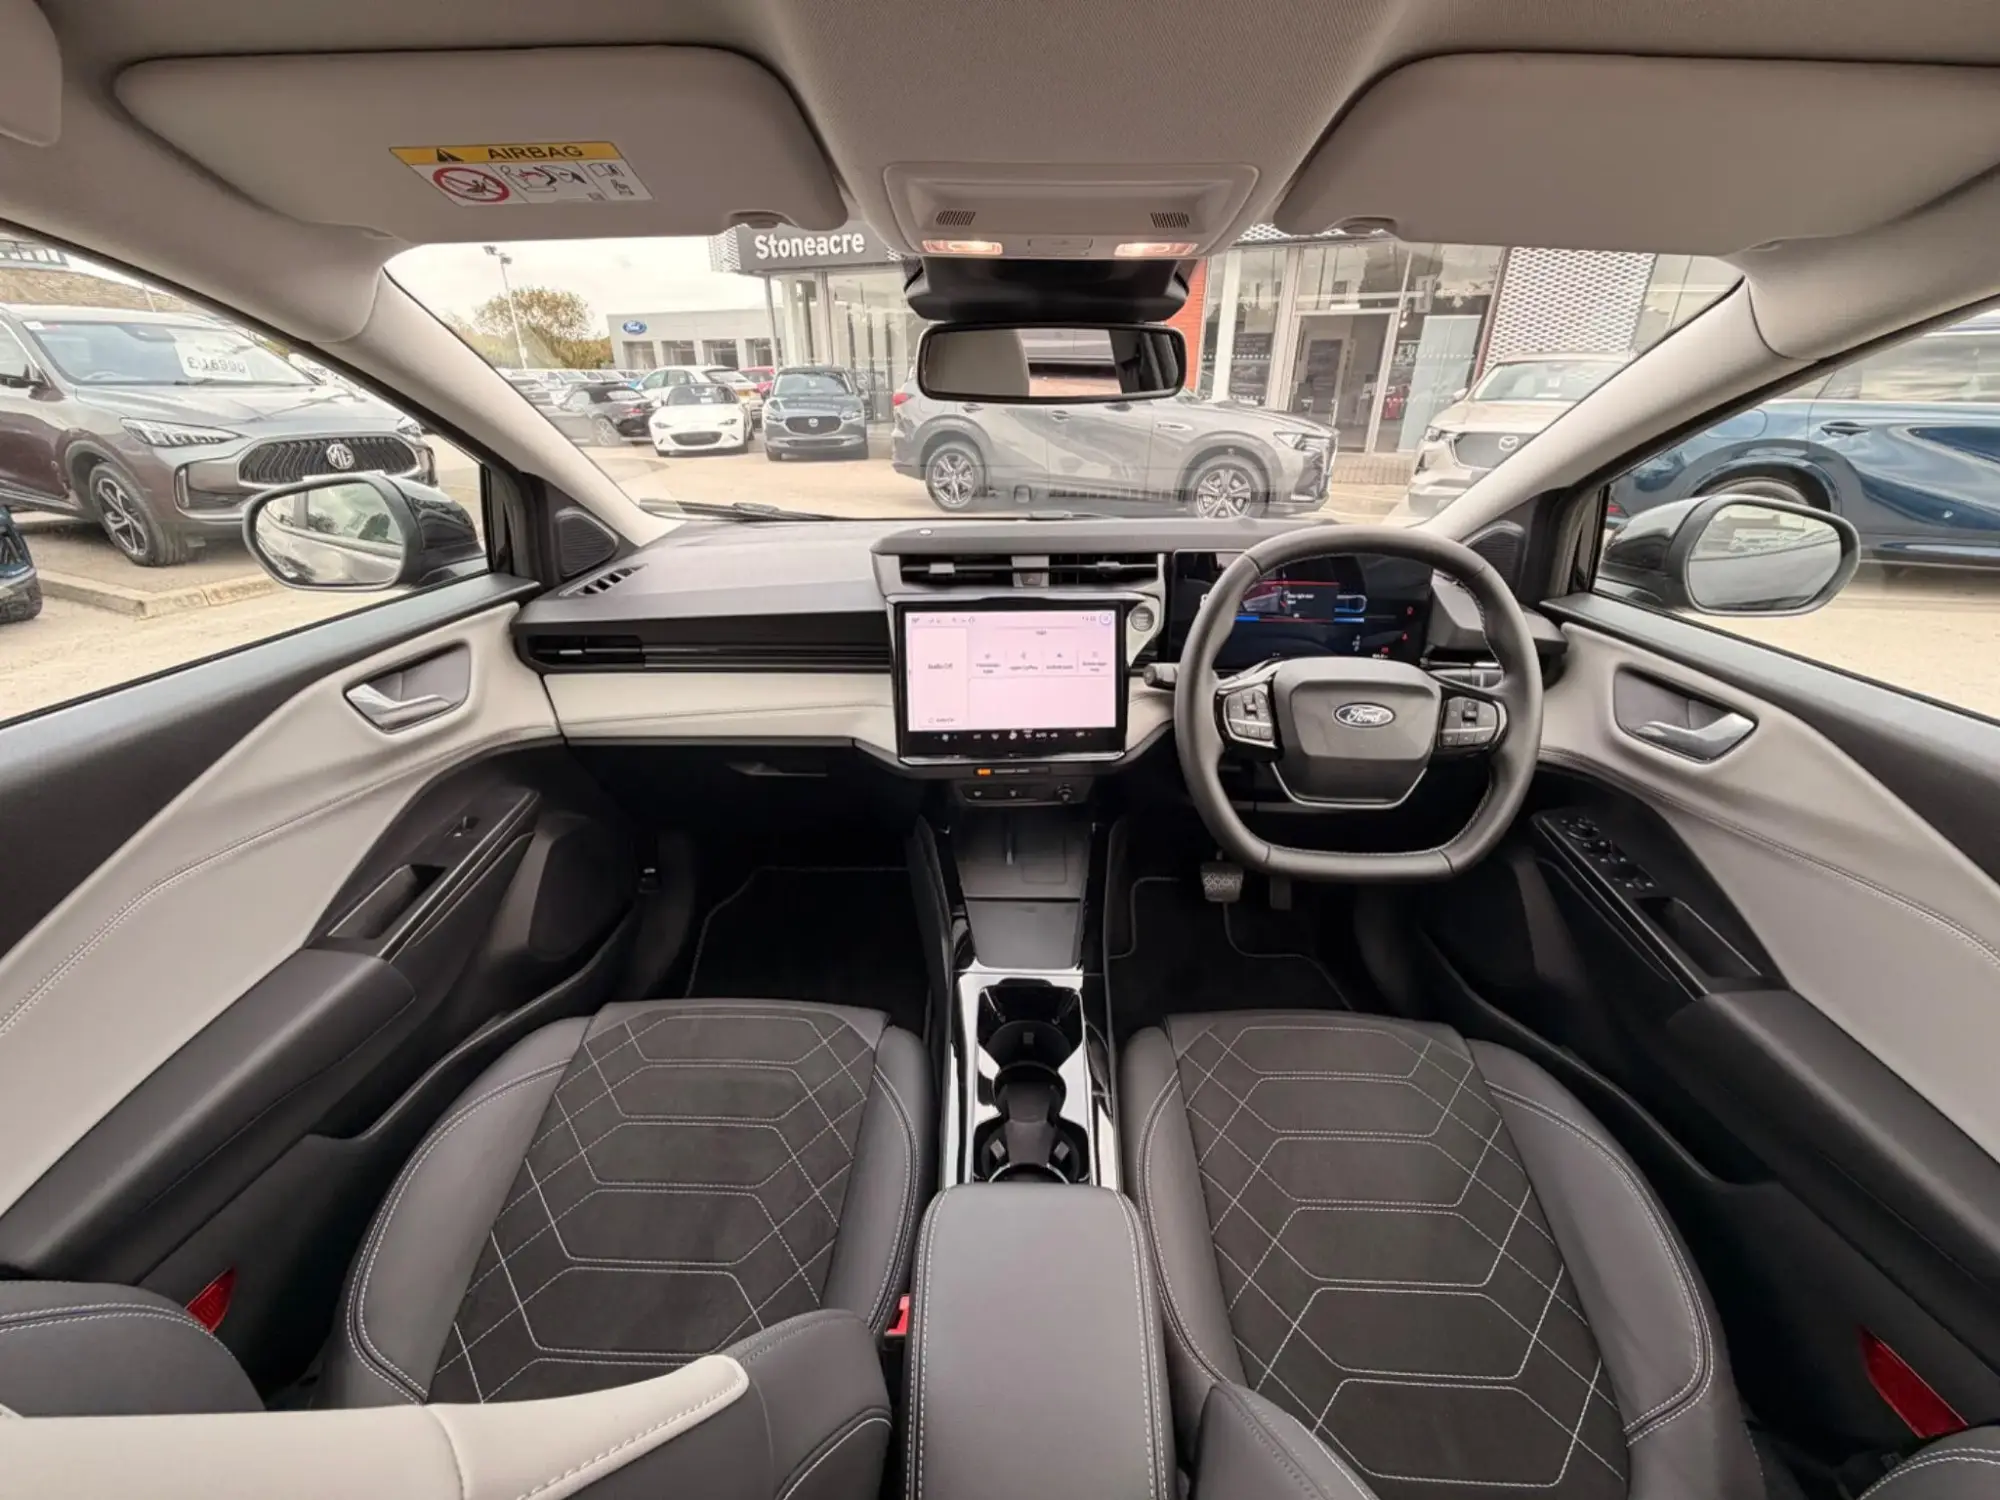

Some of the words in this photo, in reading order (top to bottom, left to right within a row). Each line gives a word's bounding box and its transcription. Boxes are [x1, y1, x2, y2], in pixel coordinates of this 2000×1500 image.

[487, 145, 584, 160] AIRBAG
[754, 232, 866, 260] Stoneacre
[327, 443, 355, 469] MG
[1346, 707, 1382, 723] Ford
